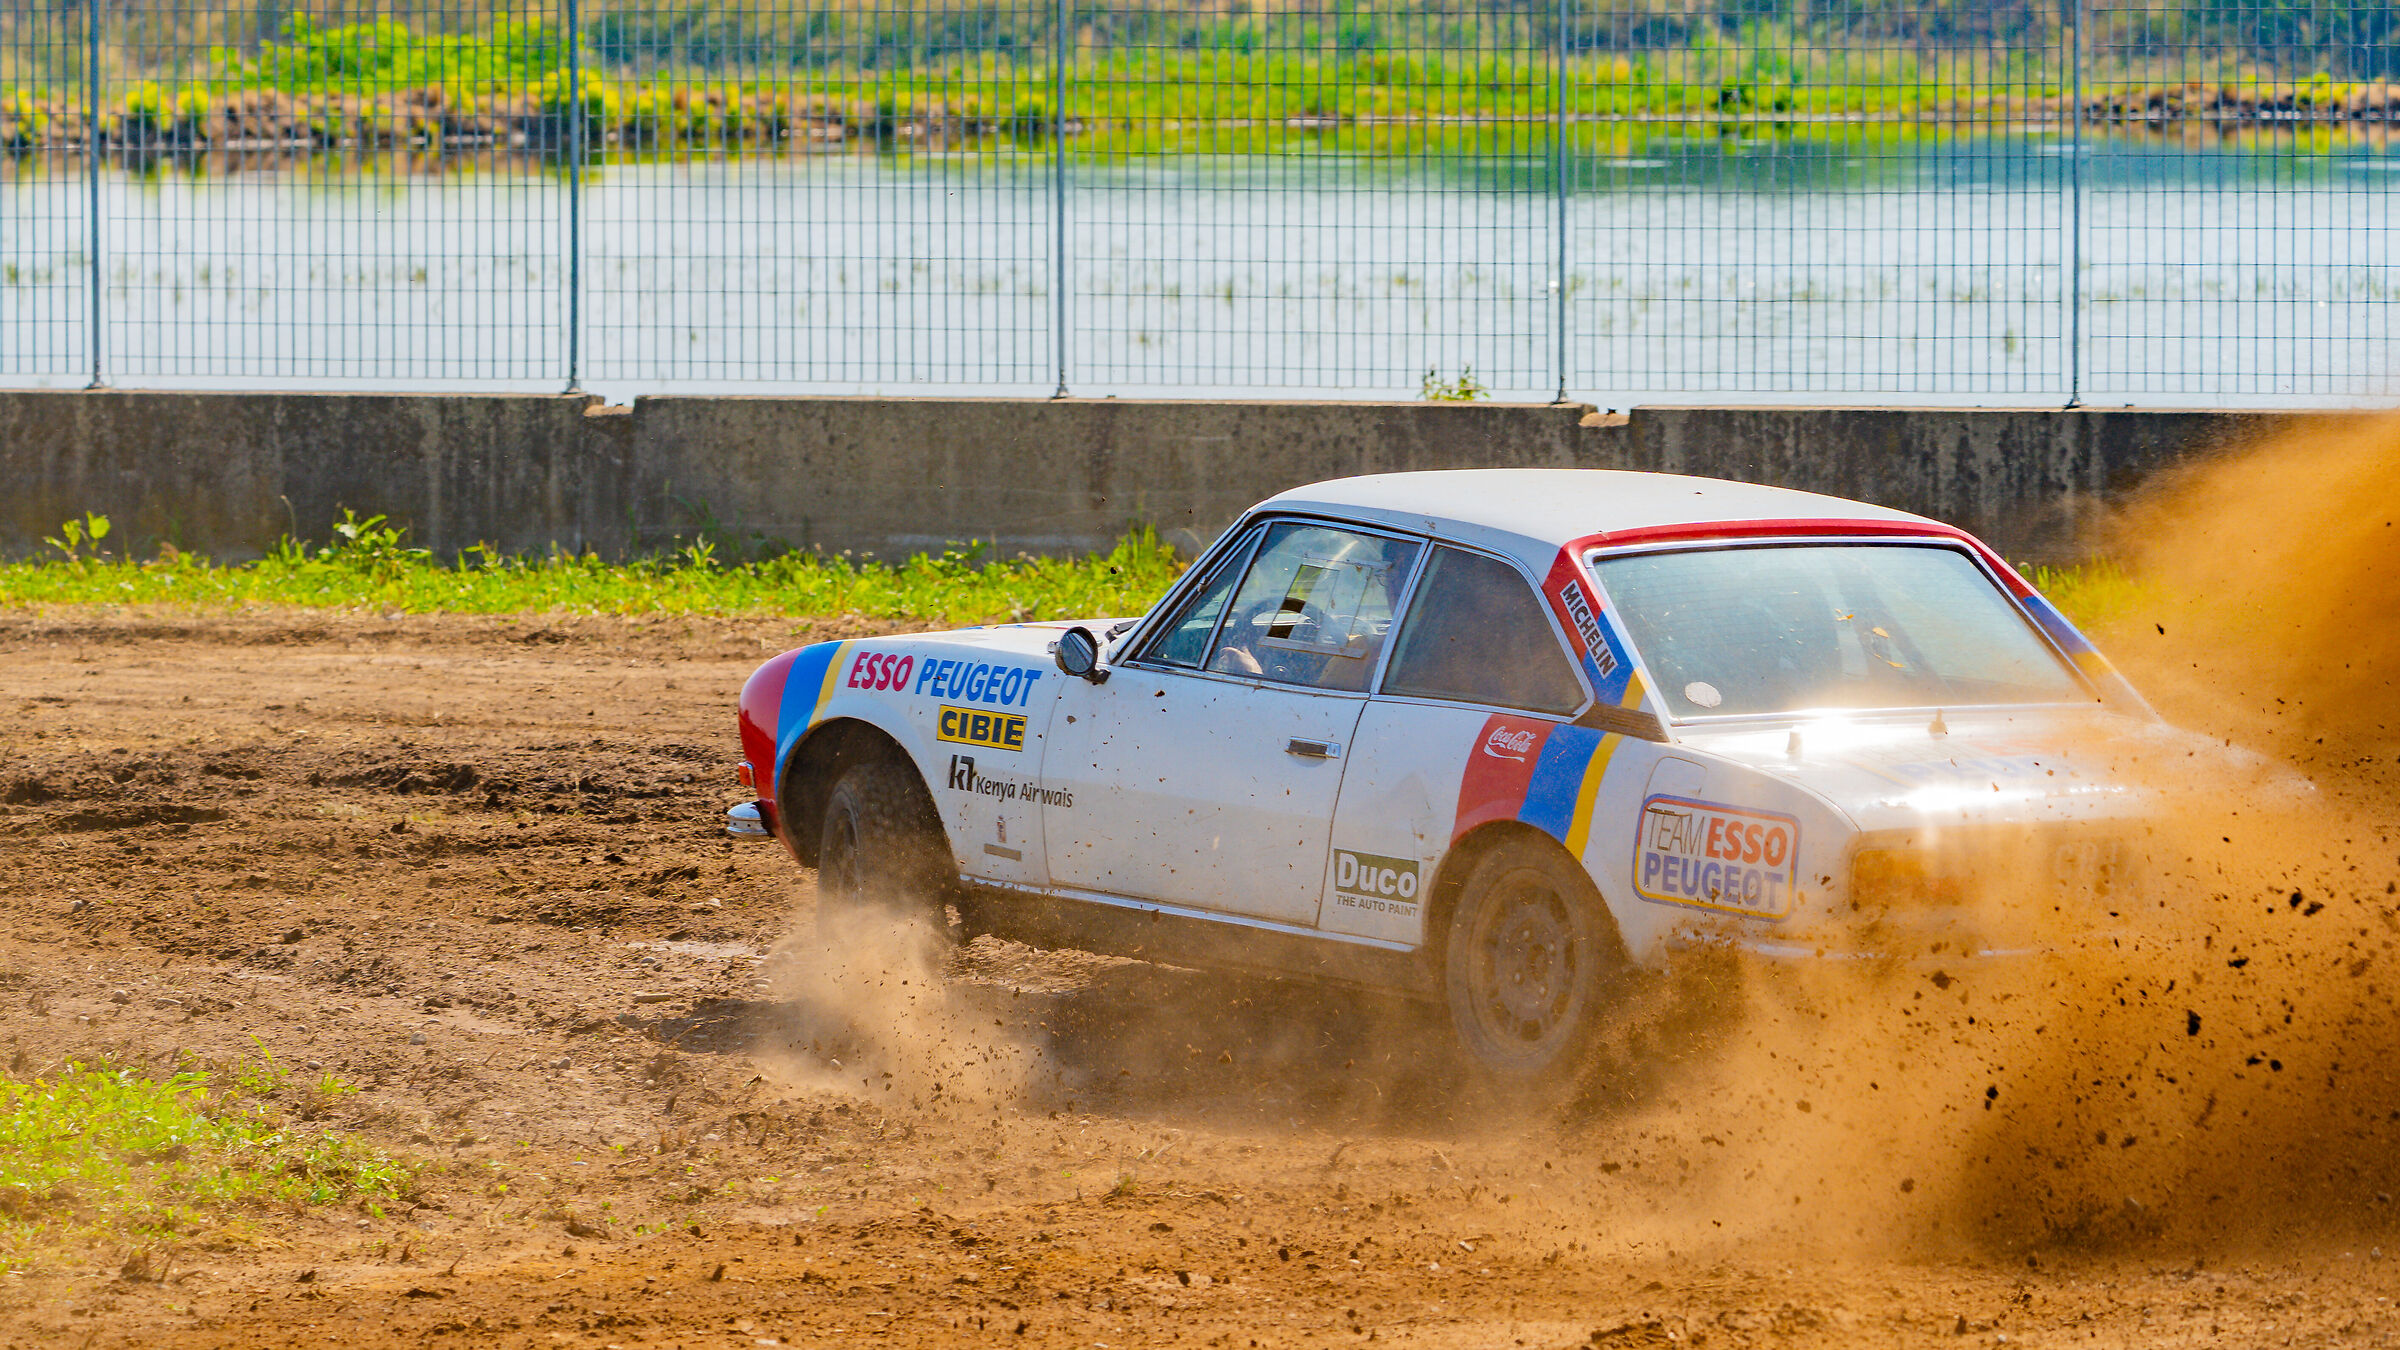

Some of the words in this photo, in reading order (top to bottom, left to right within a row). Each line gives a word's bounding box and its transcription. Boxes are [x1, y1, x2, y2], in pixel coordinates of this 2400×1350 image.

[1562, 582, 1616, 676] MICHELIN
[847, 651, 914, 692] ESSO
[915, 658, 1044, 707] PEUGEOT
[940, 710, 1025, 746] CIBIE
[976, 776, 1016, 803] Kenya
[1645, 807, 1705, 857] TEAM
[1705, 817, 1788, 867] ESSO
[1337, 852, 1417, 898] Duco
[1644, 852, 1784, 909] PEUGEOT
[1336, 895, 1356, 907] THE
[1359, 898, 1386, 912] AUTO
[1388, 903, 1417, 917] PAINT
